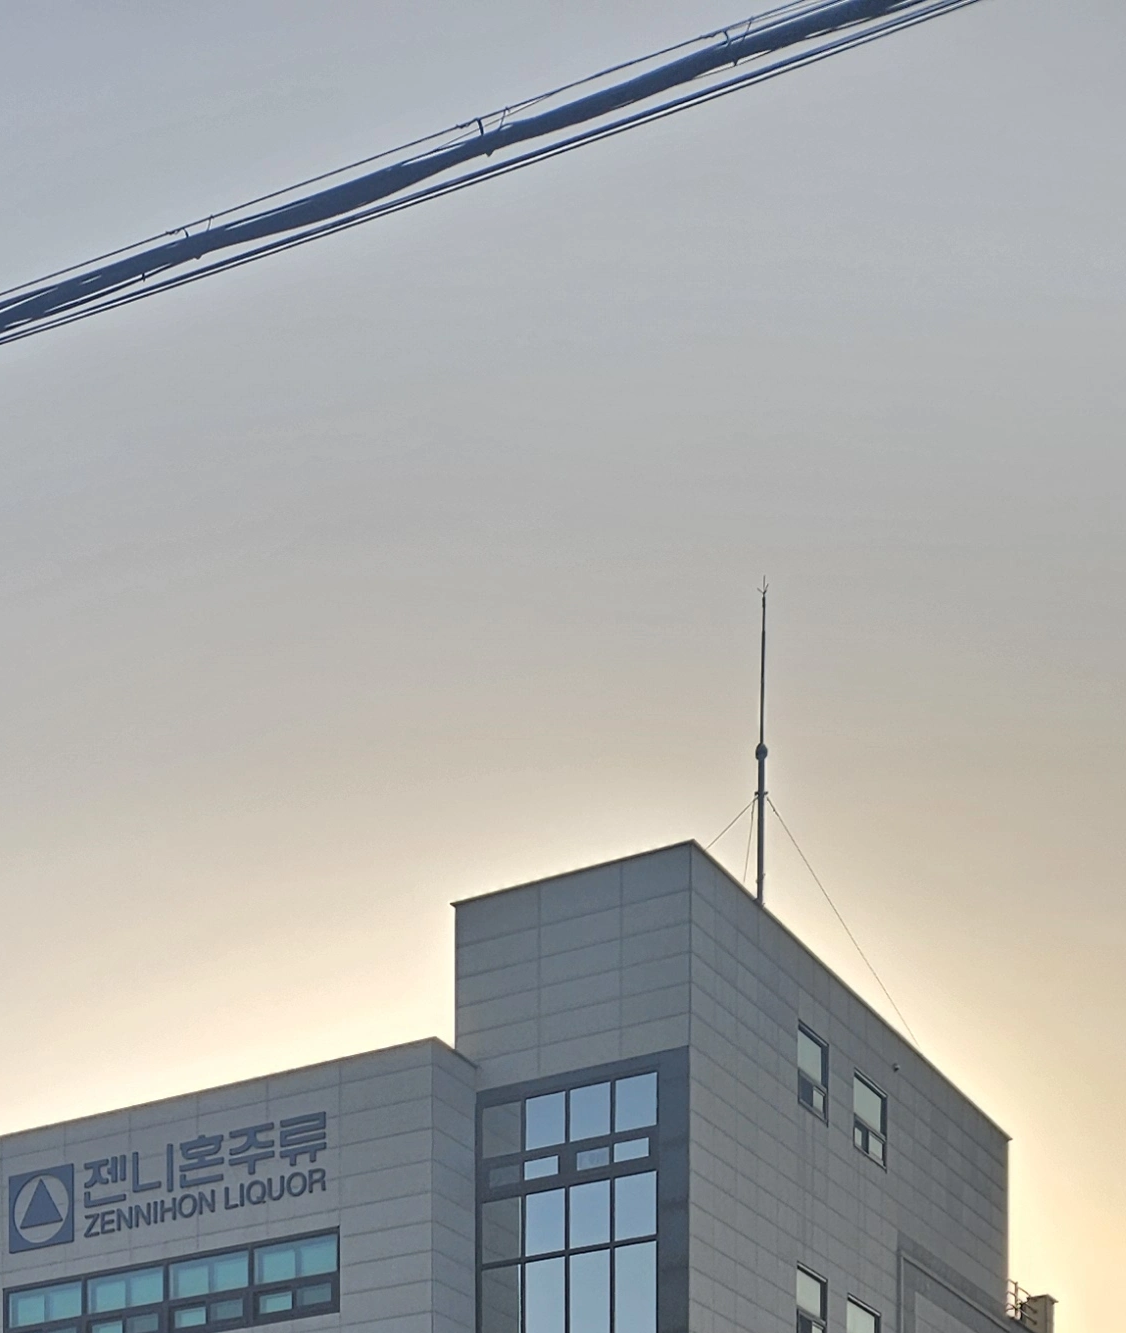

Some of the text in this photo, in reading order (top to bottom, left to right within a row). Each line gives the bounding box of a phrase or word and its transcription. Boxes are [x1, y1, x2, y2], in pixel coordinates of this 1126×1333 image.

[83, 1111, 328, 1209] 젠니혼주류
[83, 1167, 327, 1239] ZENNIHON LIQUOR
